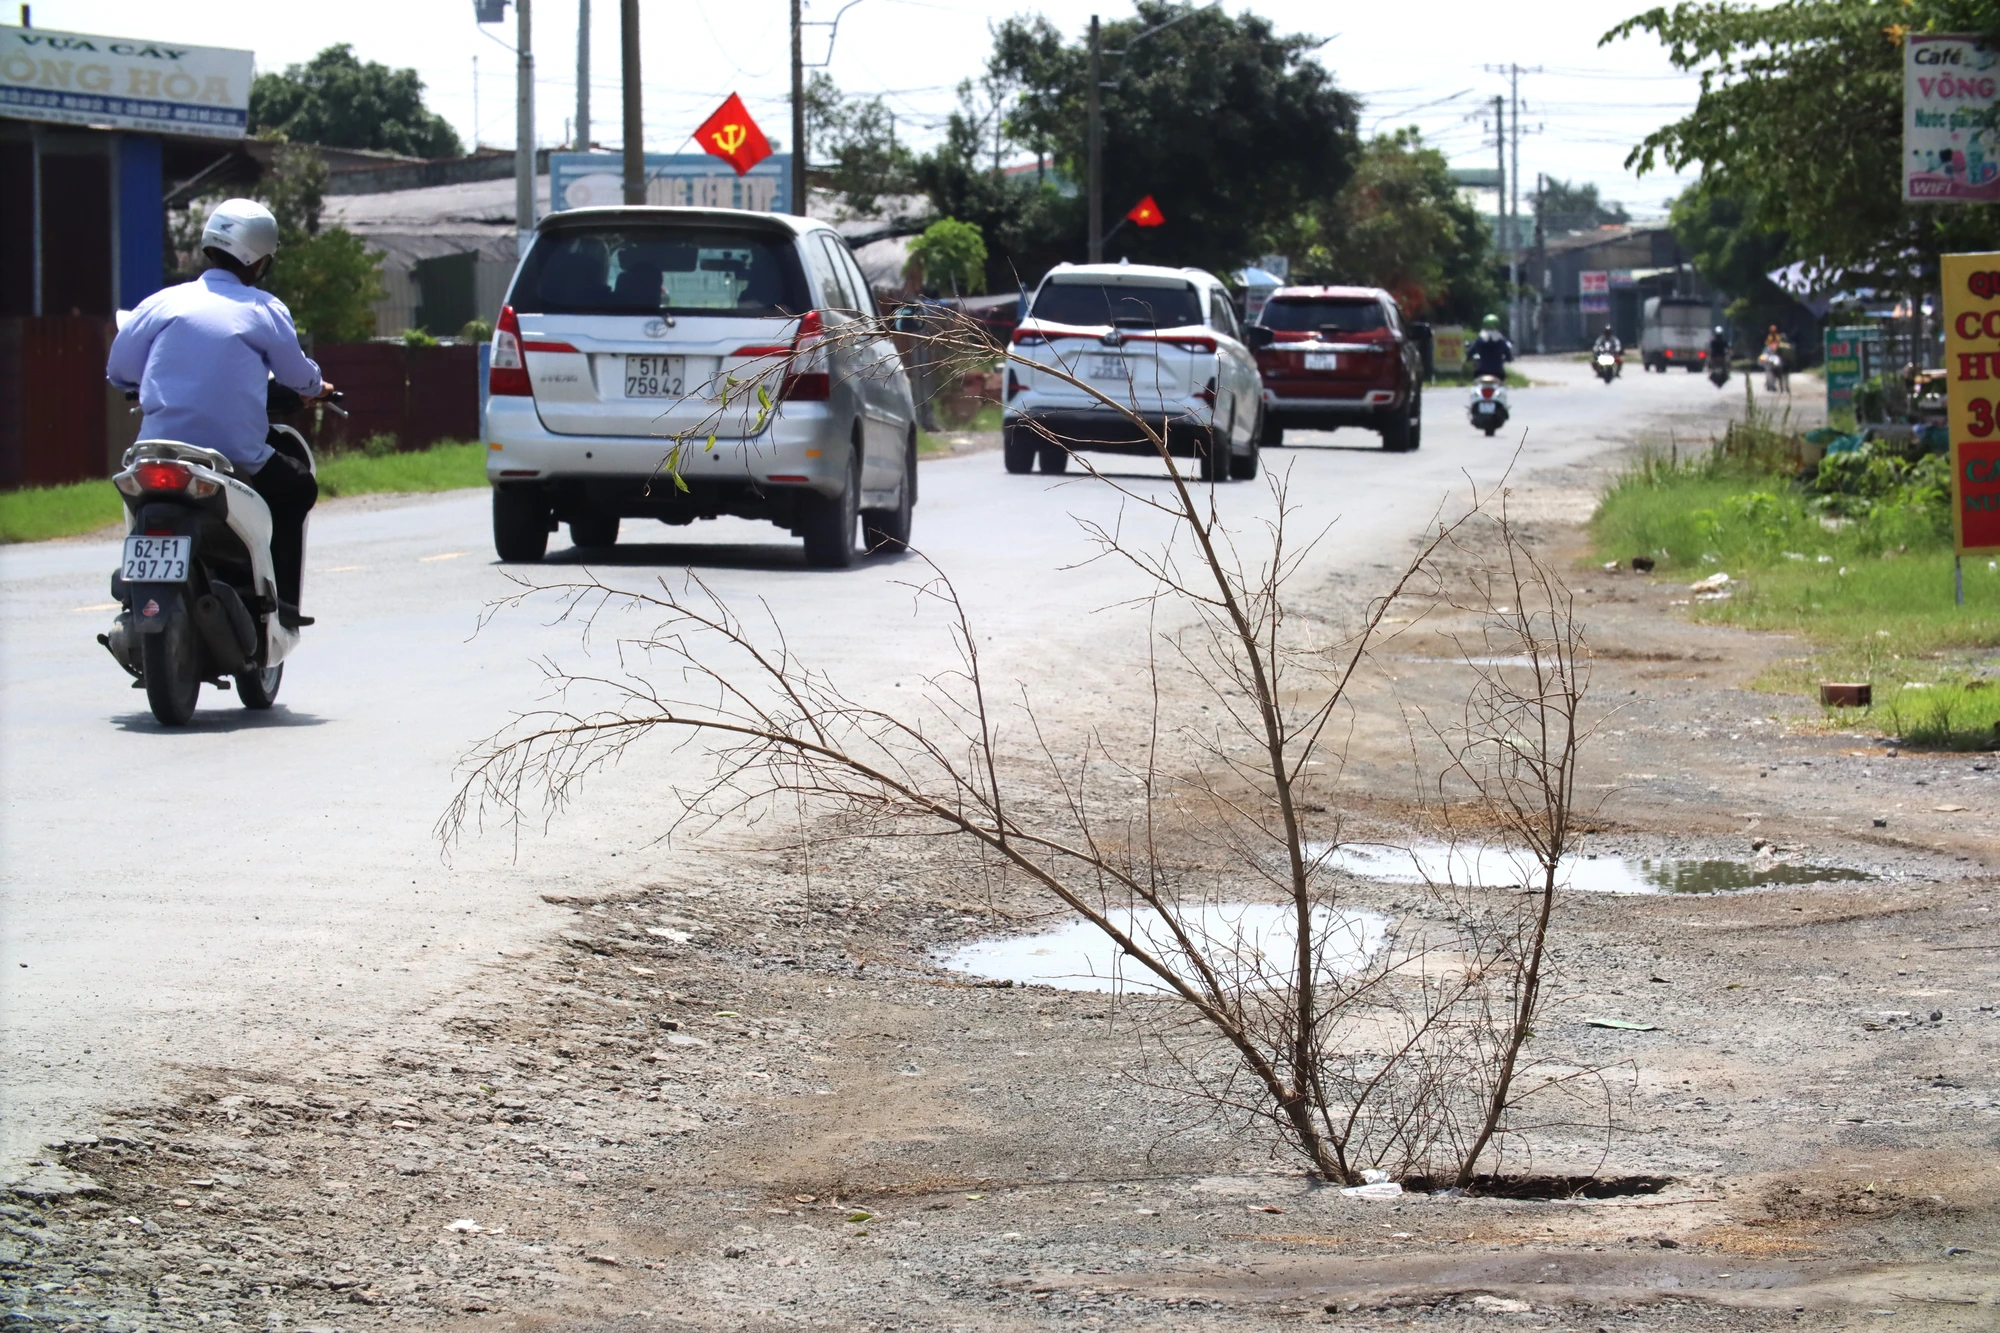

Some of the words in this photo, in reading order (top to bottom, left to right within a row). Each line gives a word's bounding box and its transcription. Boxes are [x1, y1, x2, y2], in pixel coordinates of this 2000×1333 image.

[1914, 47, 1963, 66] Café
[640, 358, 670, 376] 51A
[628, 377, 683, 396] 759.42
[134, 540, 179, 558] 62-F1
[126, 560, 185, 579] 297.73
